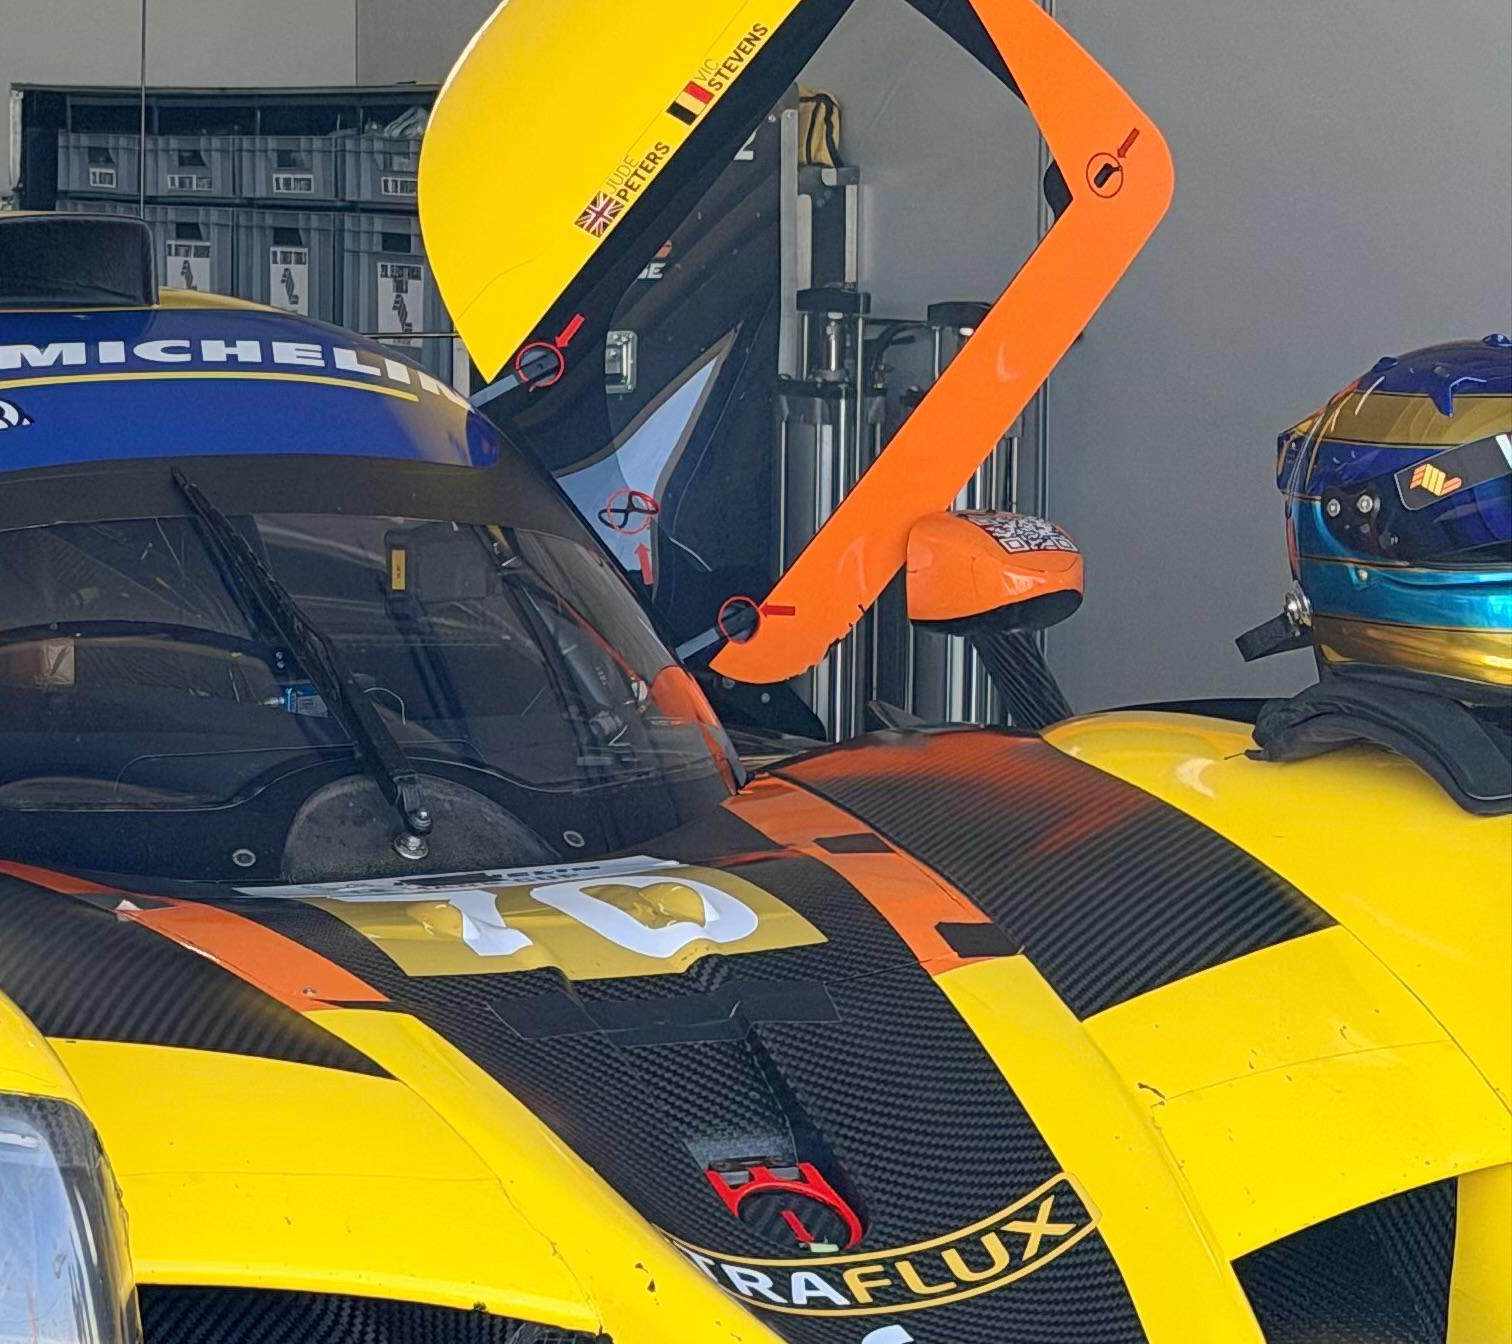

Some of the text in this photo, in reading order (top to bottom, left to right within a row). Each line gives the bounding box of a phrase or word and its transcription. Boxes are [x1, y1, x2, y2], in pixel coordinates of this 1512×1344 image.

[694, 58, 720, 83] VIC
[707, 22, 769, 92] STEVENS
[604, 154, 640, 195] JUDE
[615, 140, 671, 204] PETERS
[433, 875, 760, 958] 10
